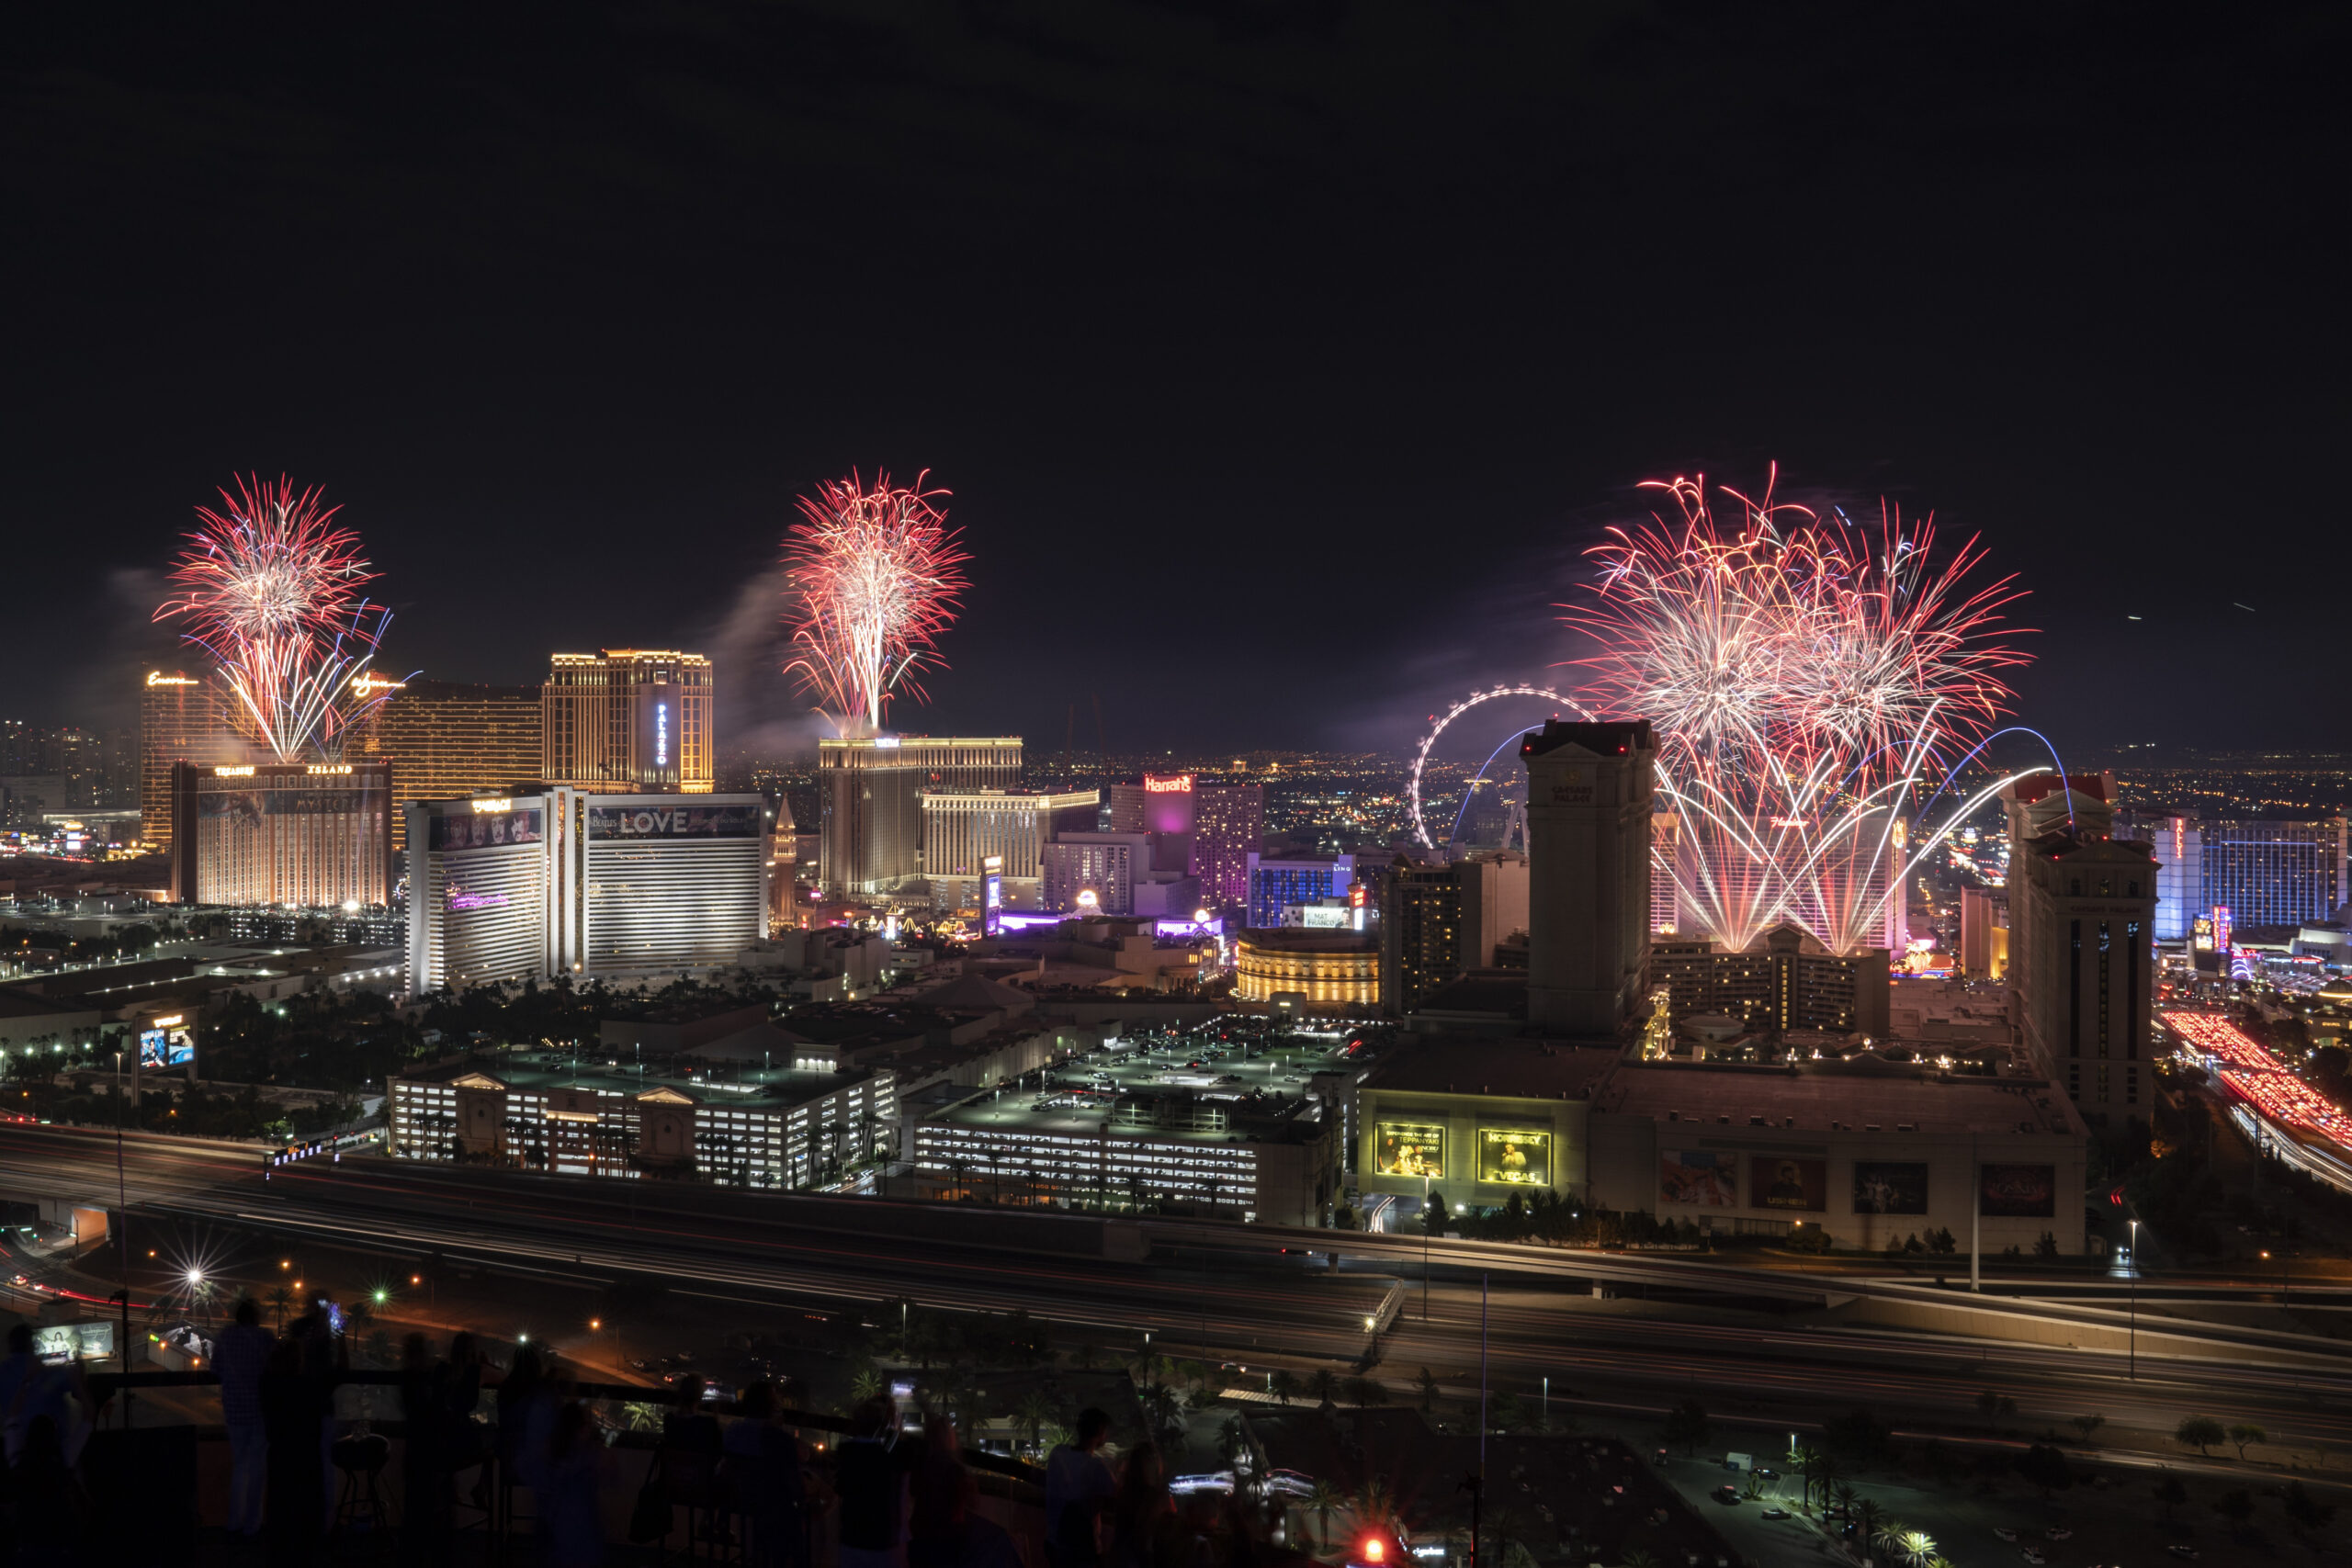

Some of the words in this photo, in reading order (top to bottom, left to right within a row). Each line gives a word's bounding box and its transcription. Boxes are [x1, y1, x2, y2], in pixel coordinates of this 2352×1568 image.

[147, 671, 199, 686] Encore
[657, 705, 667, 764] PALAZZO
[307, 765, 353, 774] ISLAND
[1552, 785, 1593, 794] CAESARS
[620, 812, 687, 833] LOVE
[1399, 1136, 1440, 1145] TEPPANYAKI
[1499, 1171, 1536, 1182] VEGAS
[1766, 1196, 1807, 1206] USHER
